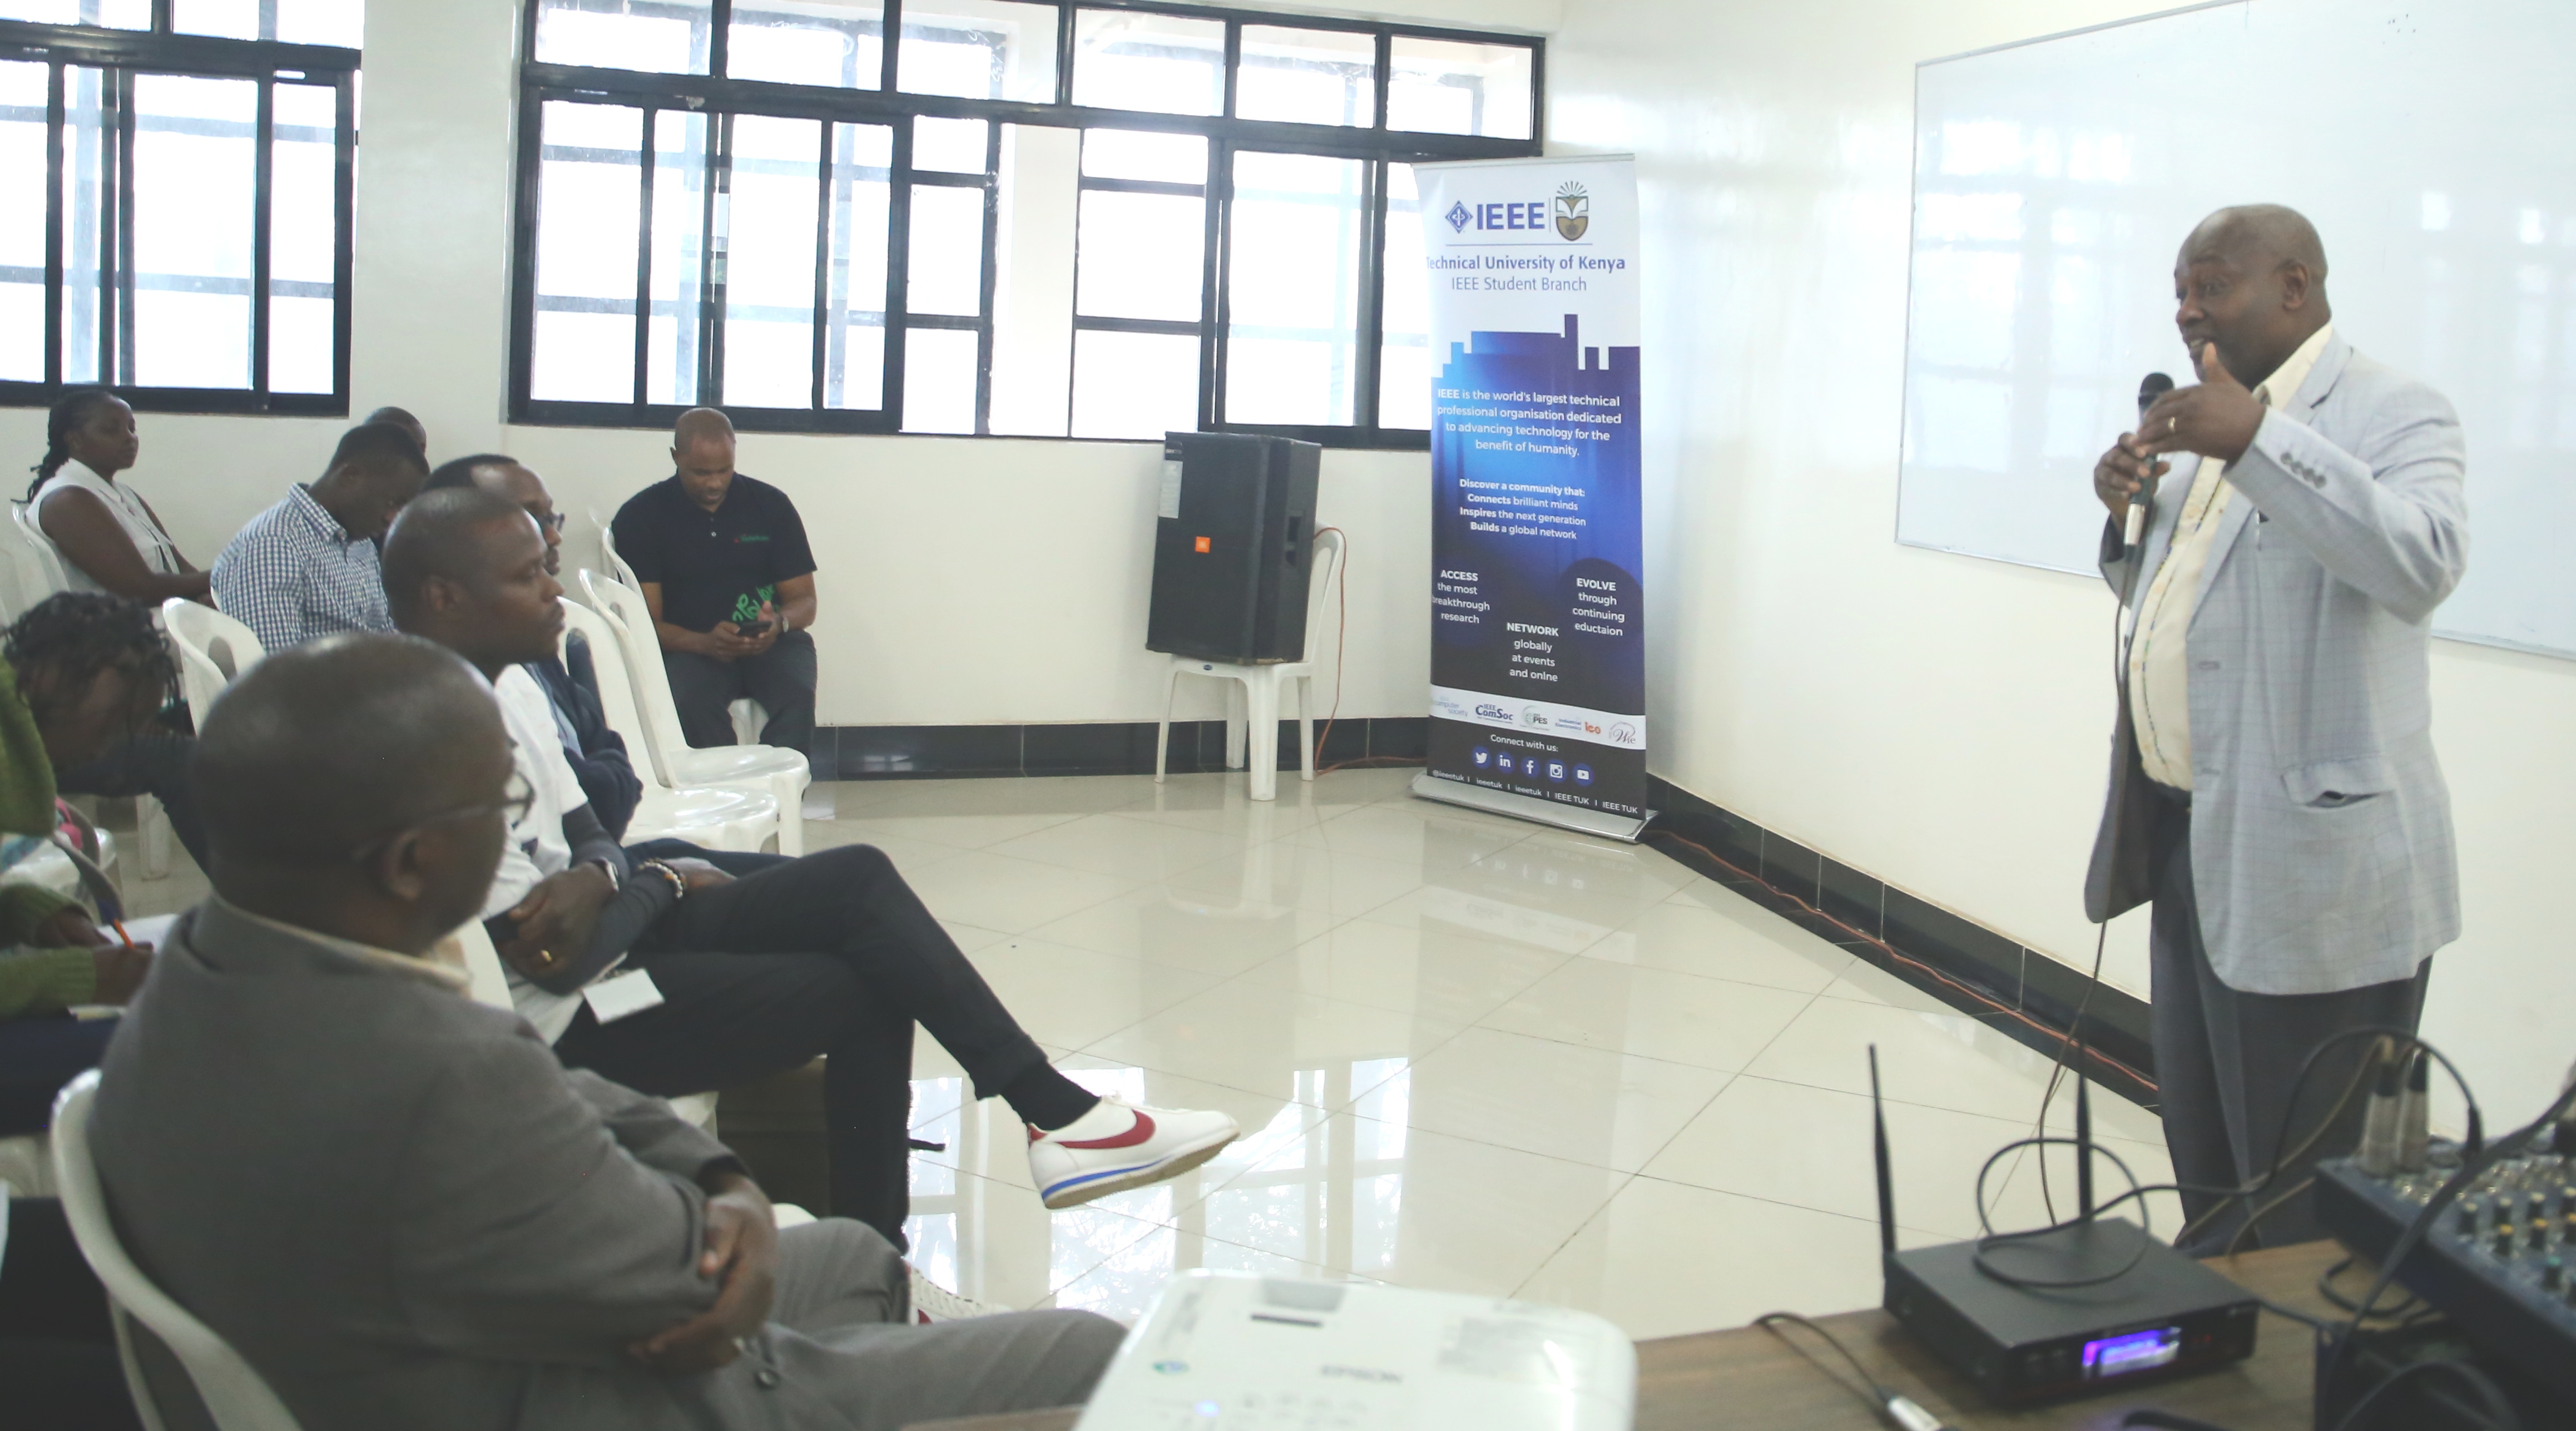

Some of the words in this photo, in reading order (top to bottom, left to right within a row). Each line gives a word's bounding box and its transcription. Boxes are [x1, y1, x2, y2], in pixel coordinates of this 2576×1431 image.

[1477, 203, 1545, 230] IEEE
[1485, 256, 1554, 273] University
[1560, 255, 1574, 270] of
[1579, 256, 1626, 273] Kenya
[1452, 277, 1479, 290] IEEE
[1484, 277, 1537, 290] Student
[1542, 277, 1587, 291] Branch
[1438, 389, 1460, 399] IEEE
[1463, 390, 1470, 399] is
[1473, 390, 1490, 400] the
[1493, 391, 1531, 402] world's
[1533, 392, 1567, 405] largest
[1570, 394, 1620, 407] technical
[1438, 406, 1497, 418] professional
[1500, 409, 1564, 422] organisation
[1567, 411, 1622, 424] dedicated
[1446, 422, 1456, 431] to
[1459, 423, 1513, 436] advancing
[1516, 425, 1573, 439] technology
[1576, 429, 1589, 439] for
[1592, 430, 1610, 440] the
[1476, 439, 1513, 451] benefit
[1516, 442, 1526, 452] of
[1529, 443, 1579, 457] humanity.
[1459, 479, 1499, 489] Discover
[1509, 483, 1562, 496] community
[1564, 487, 1585, 497] that:
[1468, 493, 1511, 504] Connects
[1513, 497, 1548, 508] brilliant
[1551, 499, 1578, 511] minds
[1460, 507, 1497, 518] Inspires
[1498, 510, 1513, 519] the
[1517, 512, 1536, 521] next
[1538, 514, 1586, 526] generation
[1470, 522, 1499, 532] Builds
[1509, 526, 1537, 536] global
[1540, 528, 1577, 539] network
[1441, 570, 1478, 581] ACCESS
[1438, 582, 1452, 592] the
[1454, 585, 1478, 595] most
[1577, 578, 1616, 591] EVOLVE
[1578, 592, 1617, 606] through
[1441, 612, 1479, 623] research
[1573, 607, 1625, 623] continuing
[1507, 622, 1559, 636] NETWORK
[1514, 640, 1552, 653] globally
[1512, 654, 1522, 662] at
[1524, 656, 1555, 666] events
[1510, 668, 1528, 677] and
[1476, 705, 1513, 721] ComSoc
[1533, 716, 1548, 725] PES
[1491, 734, 1524, 747] Connect
[1526, 739, 1545, 750] with
[1477, 777, 1503, 789] ieeetuk
[1515, 785, 1542, 796] ieeetuk
[1555, 793, 1572, 802] IEEE
[1574, 795, 1589, 805] TUK
[1603, 801, 1620, 811] IEEE
[1621, 804, 1638, 814] TUK
